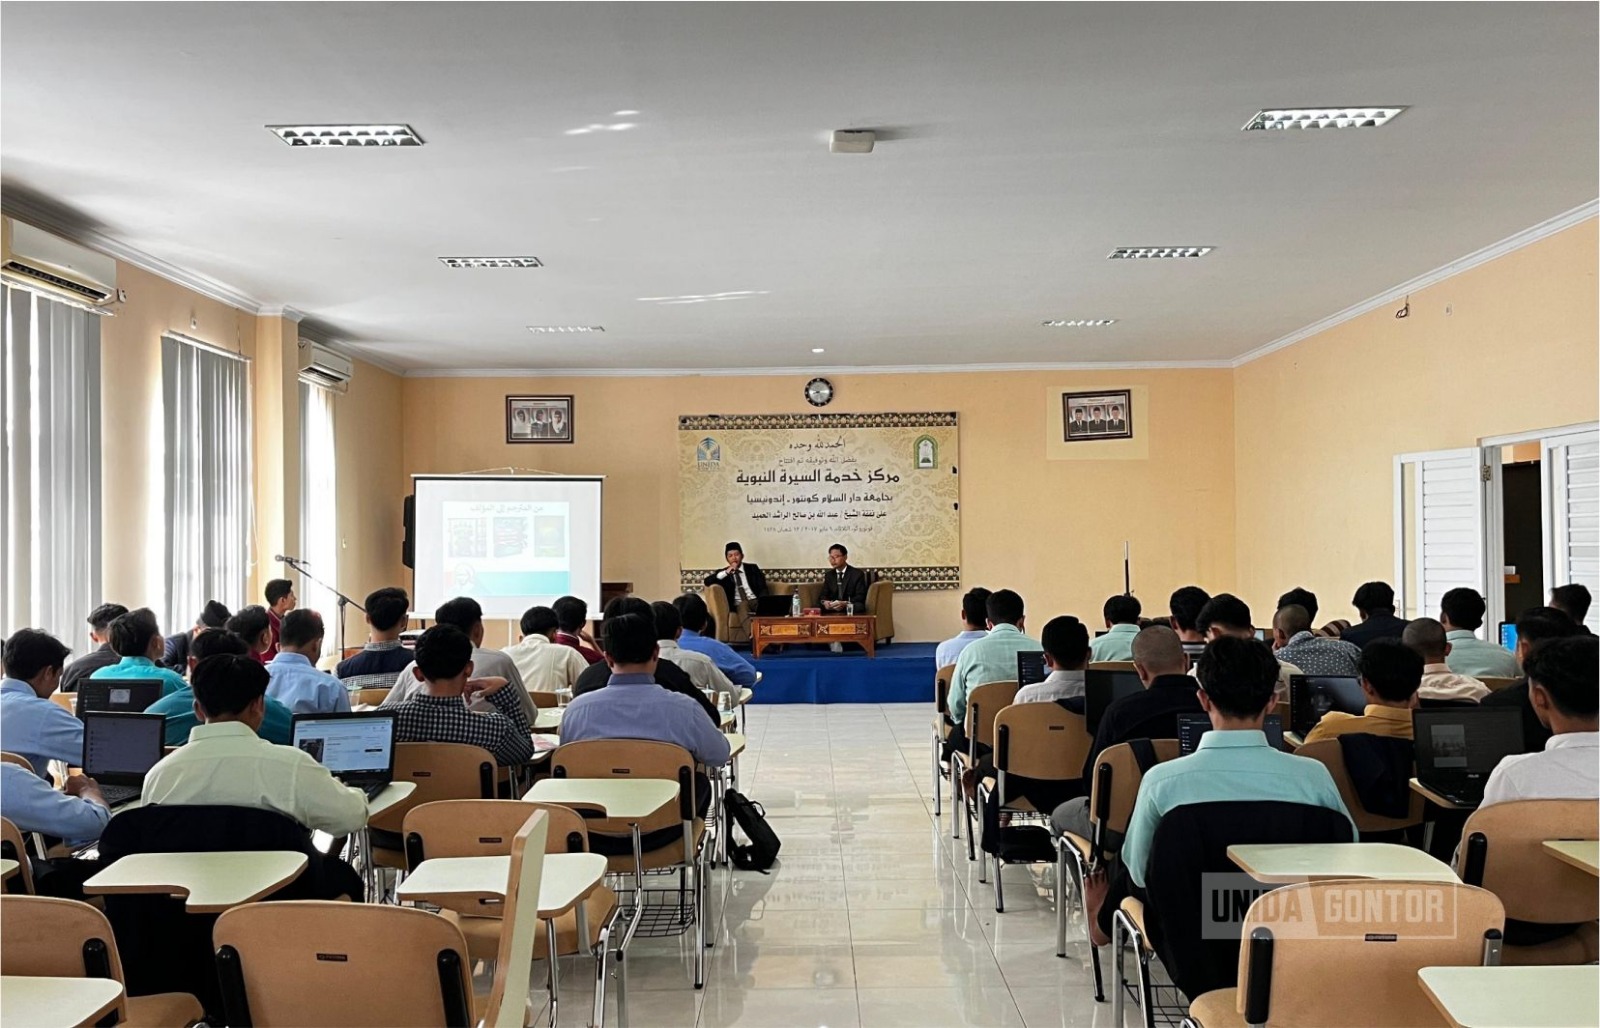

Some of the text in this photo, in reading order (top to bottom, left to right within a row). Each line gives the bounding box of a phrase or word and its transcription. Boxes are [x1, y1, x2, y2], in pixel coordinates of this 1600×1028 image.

[789, 442, 812, 451] وحده
[736, 468, 900, 486] مركز خدمة السيرة النبوية
[746, 494, 785, 505] إندونيسيا
[821, 493, 847, 503] السلام
[849, 493, 860, 503] دار
[863, 492, 893, 503] بجامعة
[816, 509, 826, 517] الله
[844, 509, 861, 520] الشيخ
